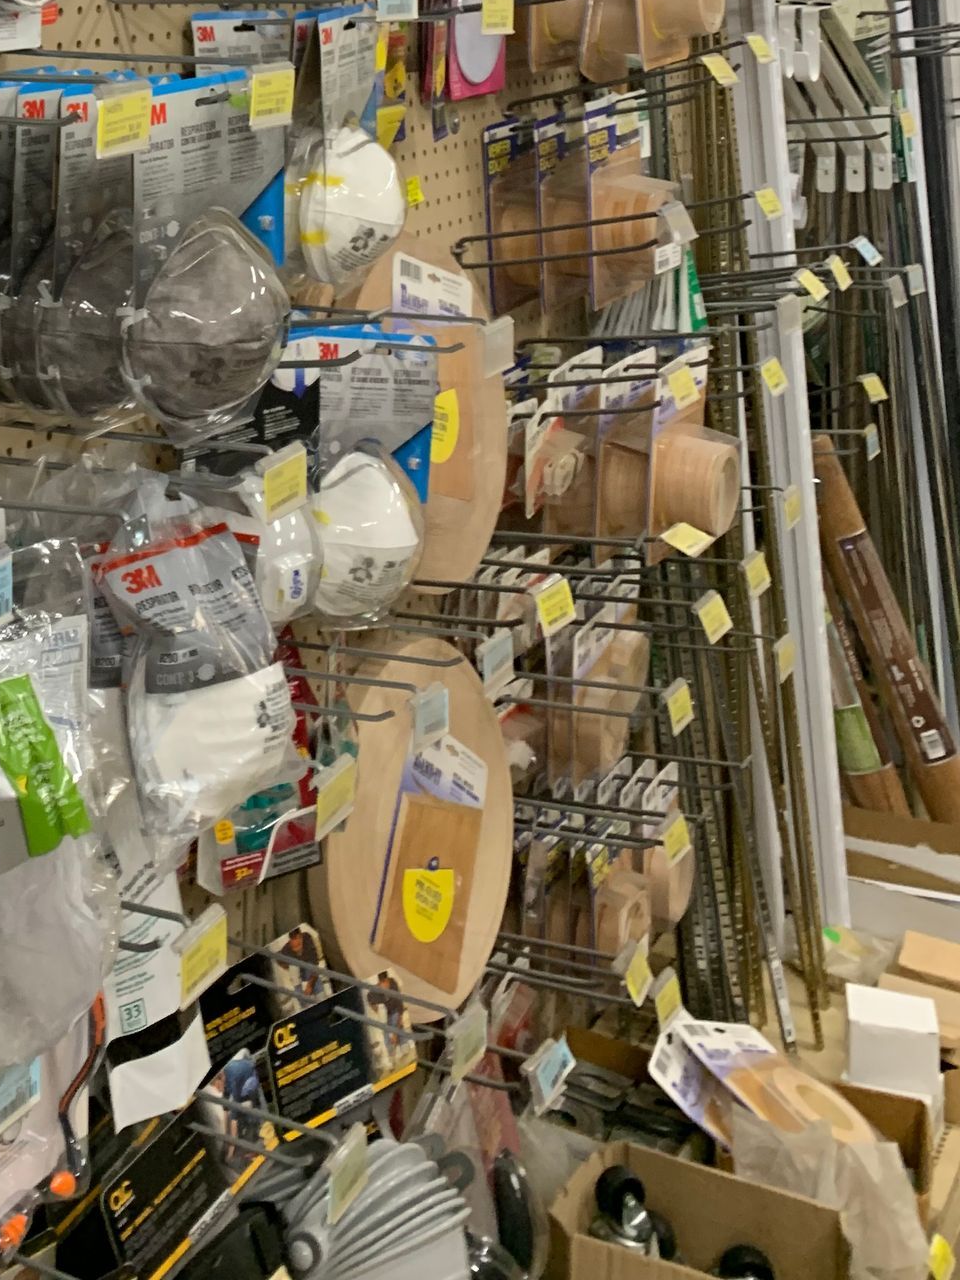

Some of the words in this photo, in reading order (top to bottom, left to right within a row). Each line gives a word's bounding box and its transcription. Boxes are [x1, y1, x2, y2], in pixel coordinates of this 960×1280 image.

[196, 25, 215, 43] 3M
[321, 27, 333, 46] 3M
[22, 98, 45, 120] 3M
[319, 342, 339, 361] 3M
[121, 564, 163, 594] 3M
[124, 1004, 142, 1022] 33
